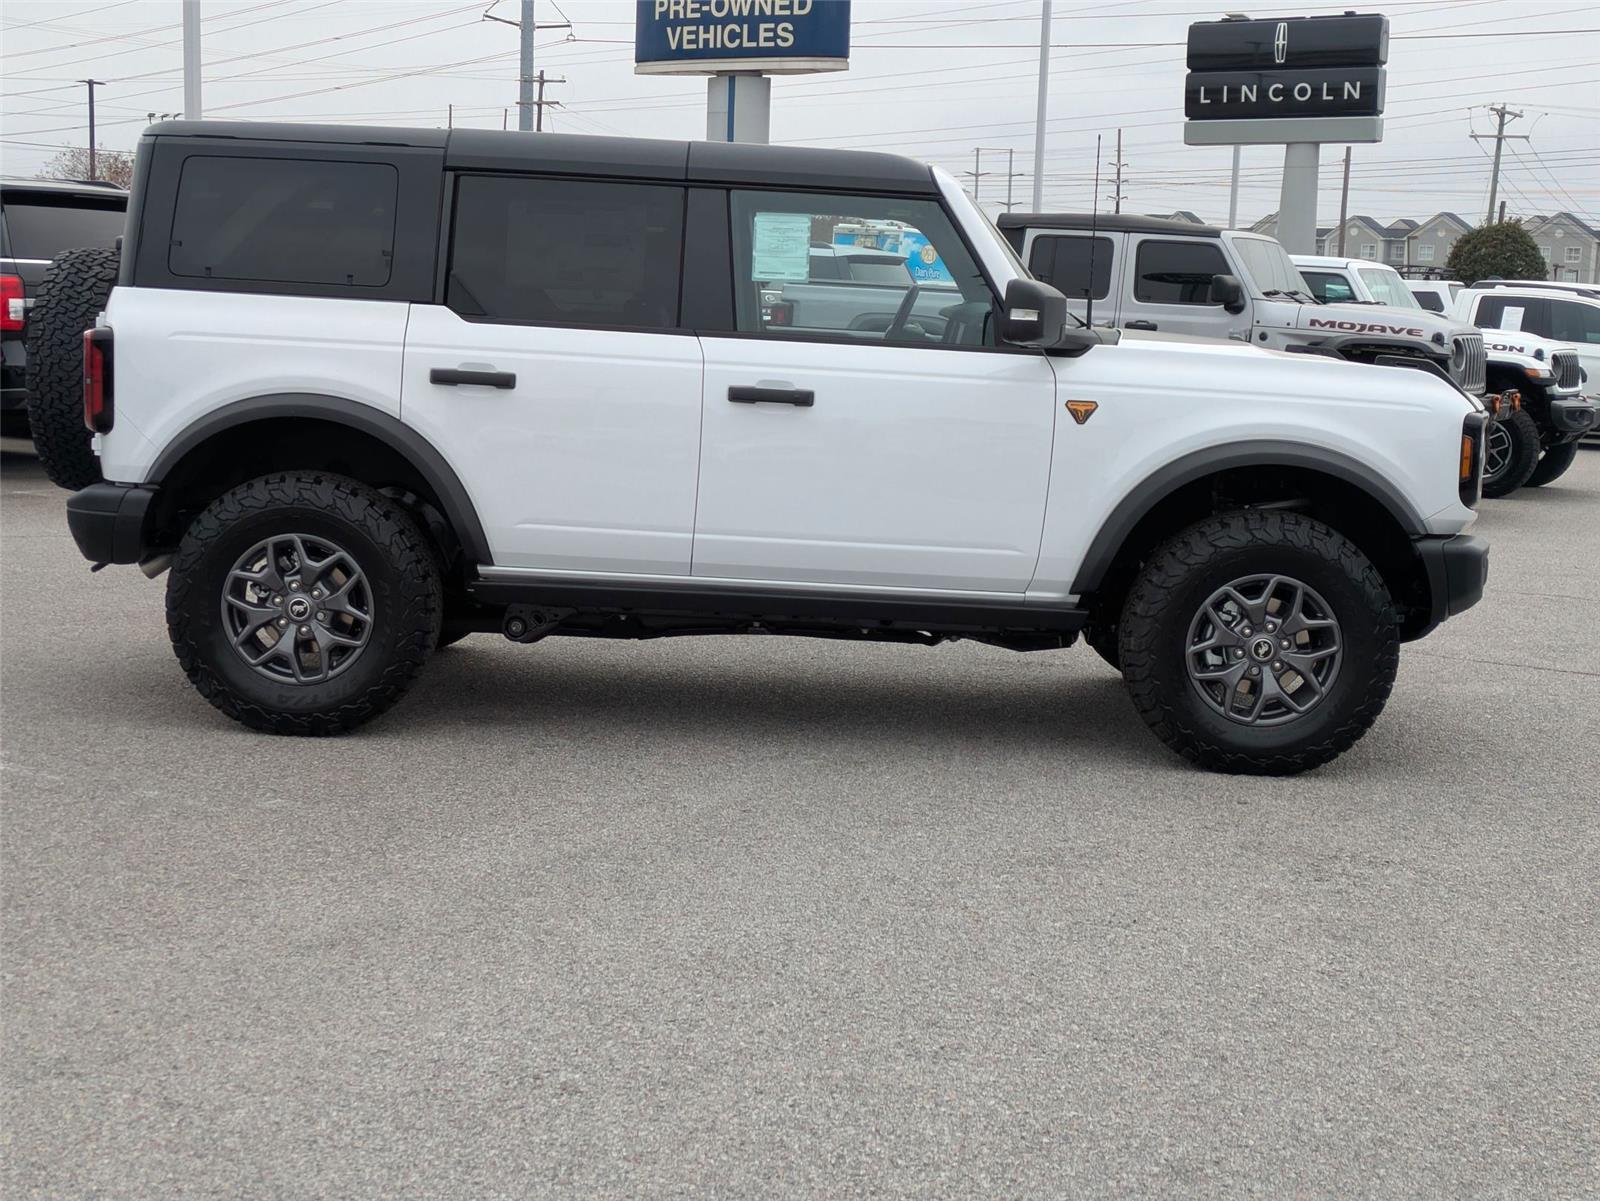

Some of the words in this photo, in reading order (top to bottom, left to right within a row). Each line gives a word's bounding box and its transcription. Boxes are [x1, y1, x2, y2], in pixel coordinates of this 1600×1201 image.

[655, 0, 812, 20] PRE-OWNED
[666, 22, 794, 50] VEHICLES
[1200, 81, 1361, 104] LINCOLN
[1309, 318, 1424, 337] MOJAVE
